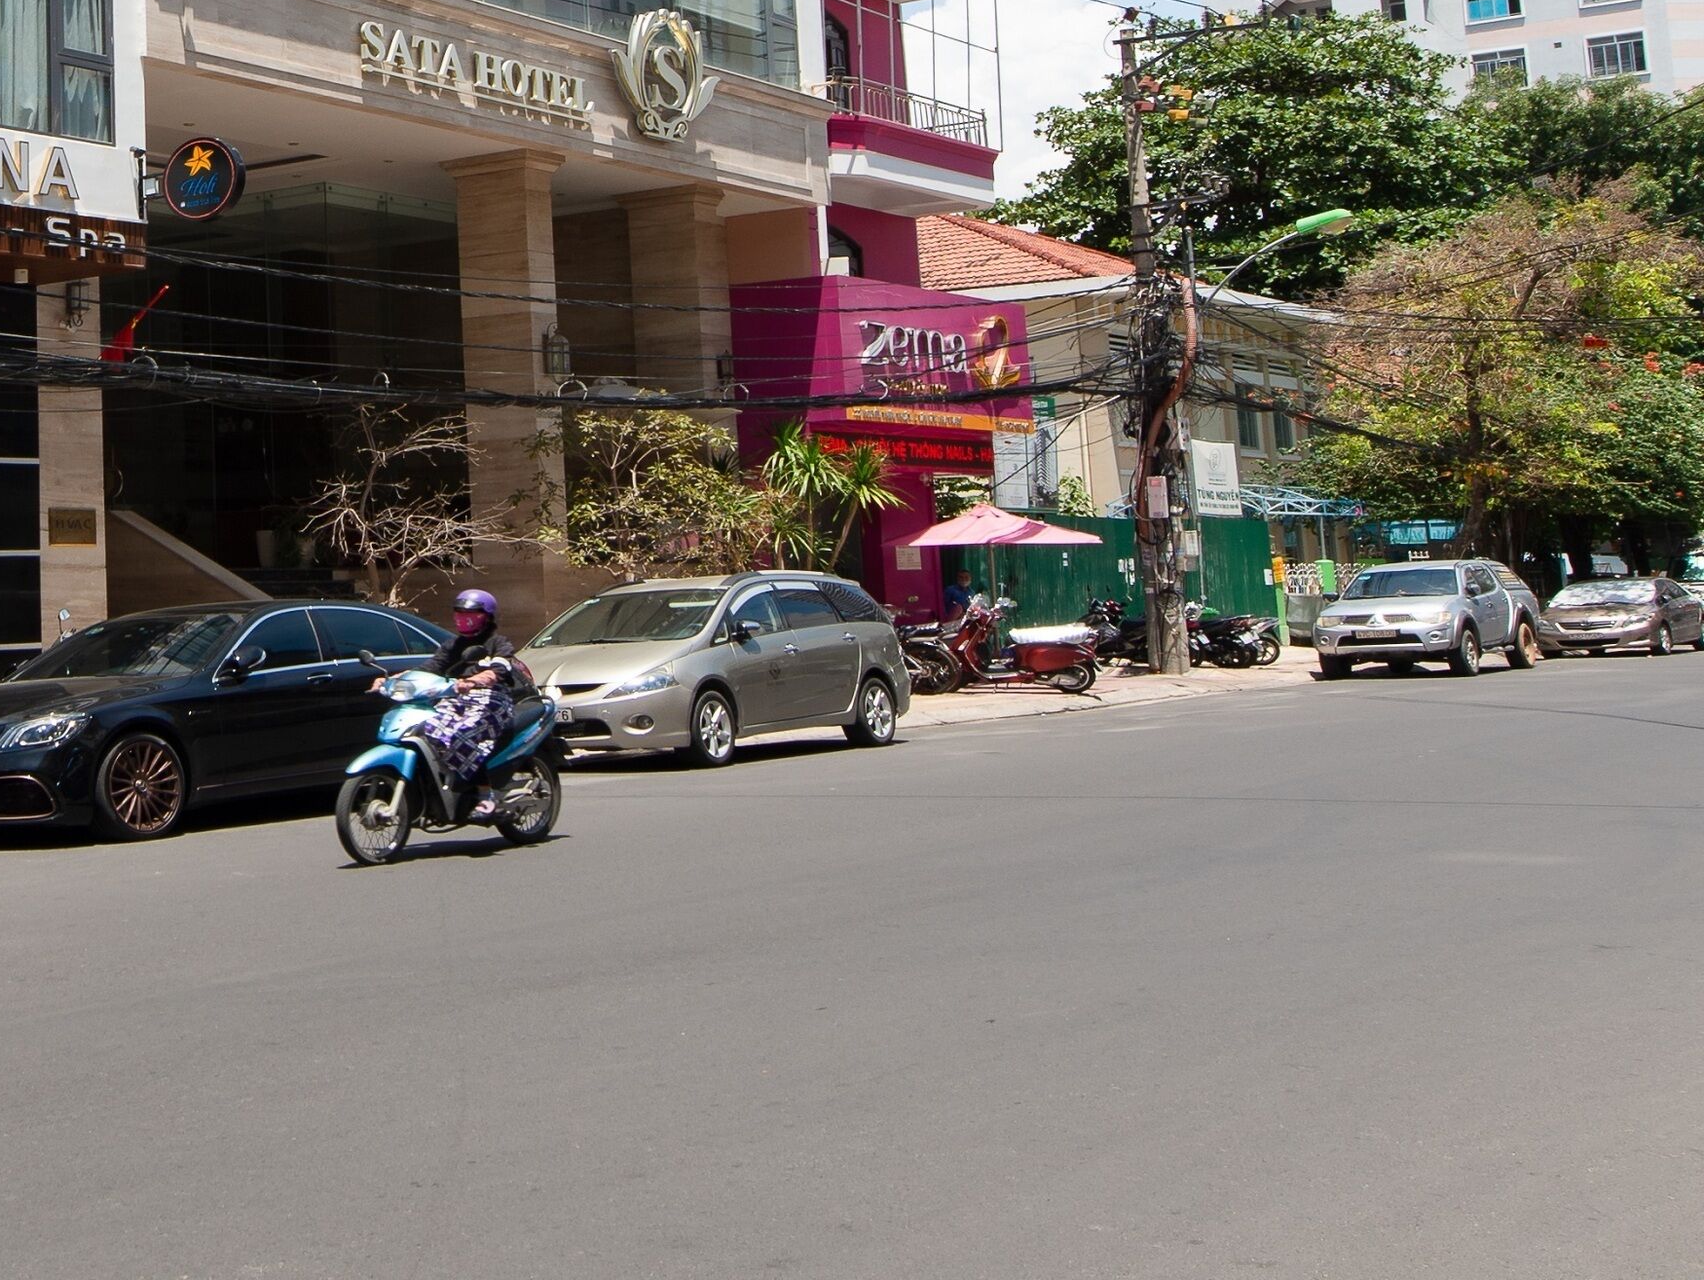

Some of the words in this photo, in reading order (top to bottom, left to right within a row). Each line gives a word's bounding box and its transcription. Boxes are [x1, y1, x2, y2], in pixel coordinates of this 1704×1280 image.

[359, 20, 467, 83] SATA
[473, 50, 595, 113] HOTEL
[43, 215, 127, 258] Spa
